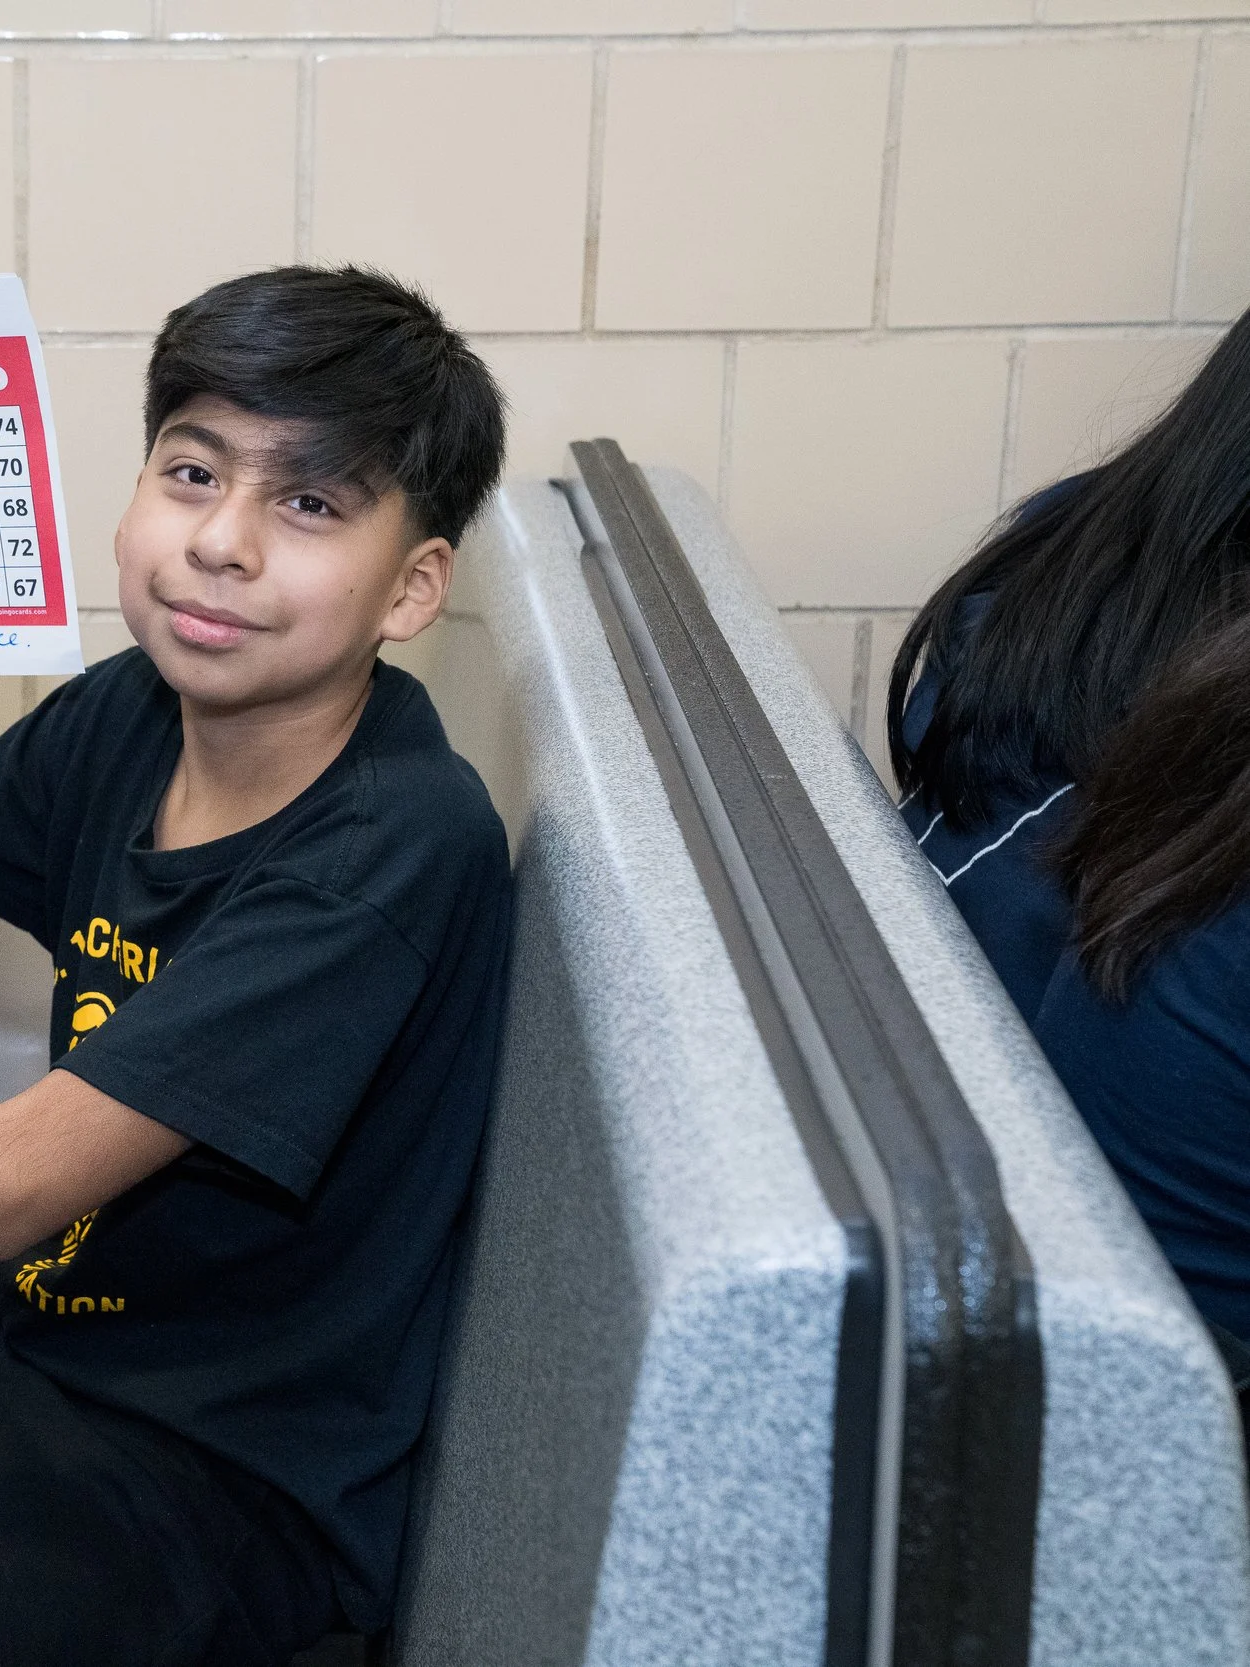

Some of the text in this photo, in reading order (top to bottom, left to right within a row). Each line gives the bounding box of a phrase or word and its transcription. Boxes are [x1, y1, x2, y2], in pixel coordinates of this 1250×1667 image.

[3, 499, 28, 516] 68
[8, 538, 34, 556] 72
[13, 579, 37, 596] 67
